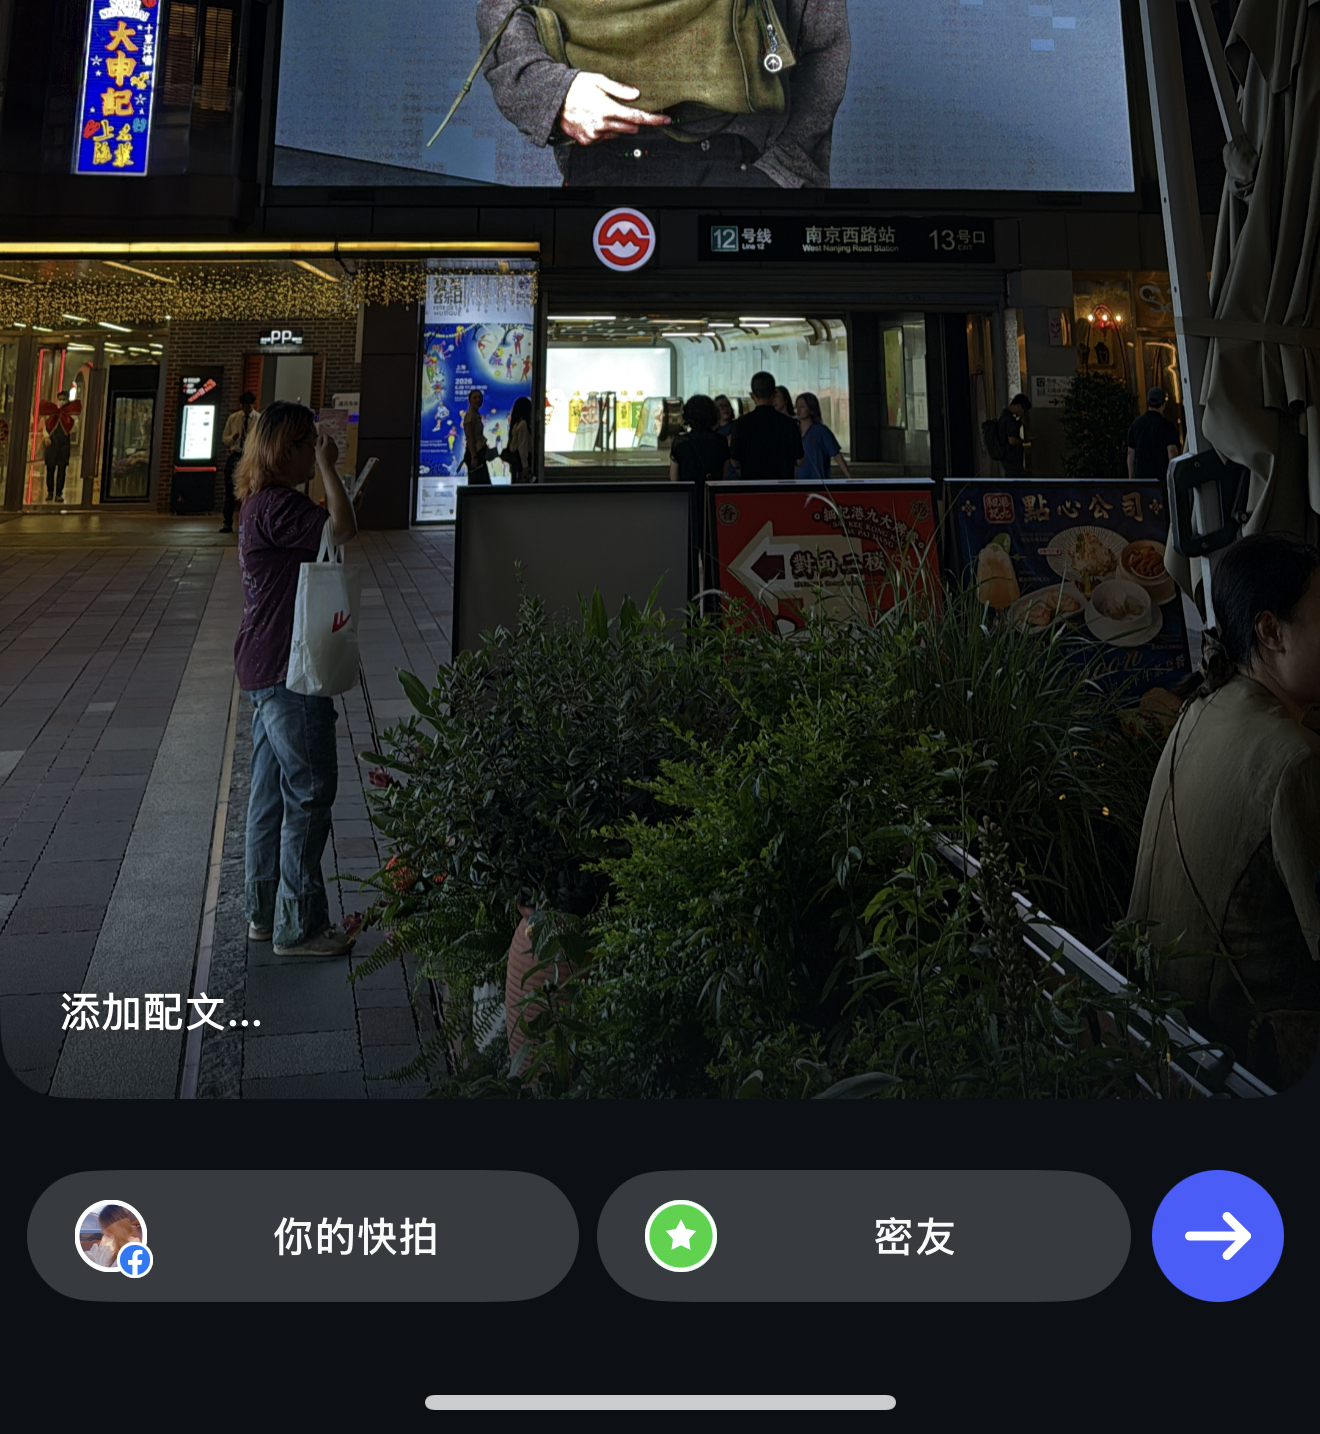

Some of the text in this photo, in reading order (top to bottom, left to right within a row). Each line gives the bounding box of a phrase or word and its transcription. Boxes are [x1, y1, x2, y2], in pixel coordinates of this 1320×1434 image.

[101, 20, 139, 116] 大申記
[805, 225, 896, 244] 南京西路站
[802, 244, 821, 252] West
[823, 244, 850, 253] Nanjing
[852, 244, 872, 252] Road
[455, 377, 473, 385] 2026
[721, 504, 735, 521] 香
[1021, 493, 1144, 523] 點心公司
